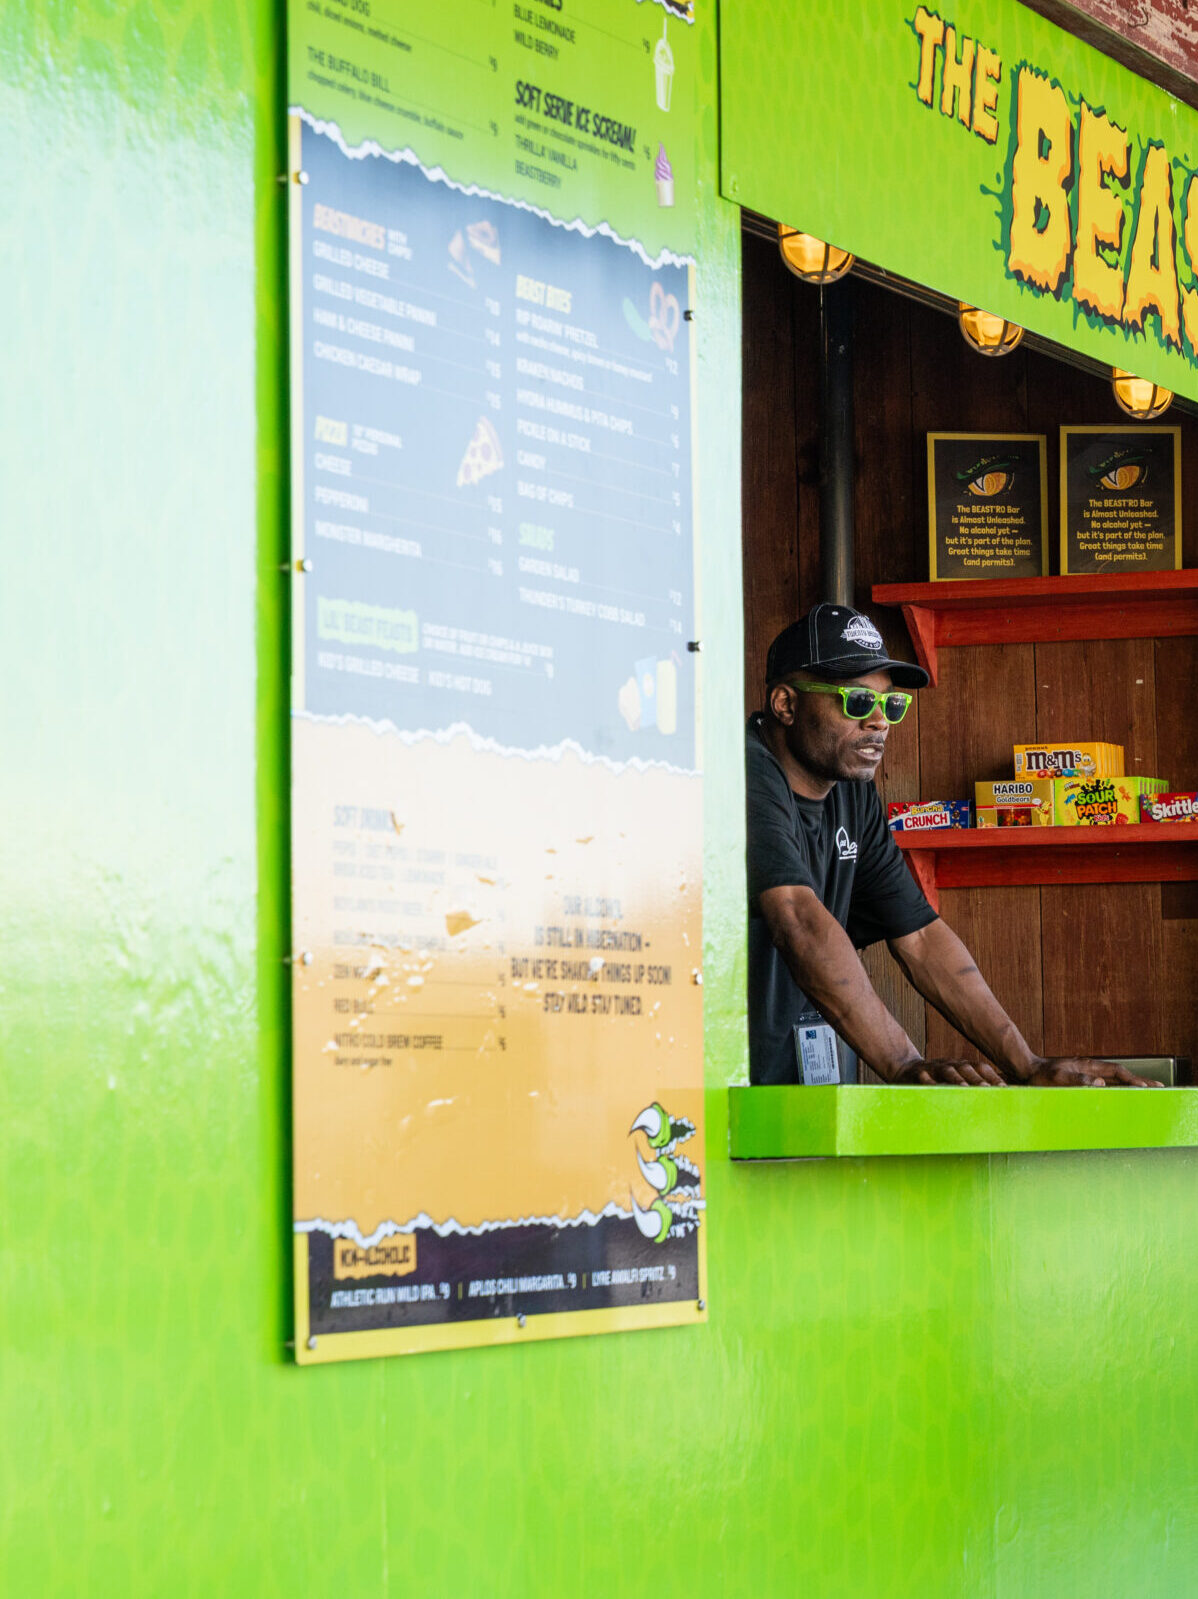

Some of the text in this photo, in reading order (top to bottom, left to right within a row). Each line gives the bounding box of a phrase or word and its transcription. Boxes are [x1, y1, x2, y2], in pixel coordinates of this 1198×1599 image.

[307, 45, 390, 93] THE BUFFALO BILL
[912, 5, 1002, 144] THE
[515, 80, 542, 113] SOFT
[543, 92, 574, 127] SERVE
[575, 105, 591, 134] ICE
[592, 112, 637, 154] SCREAM!
[313, 240, 391, 280] GRILLED CHEESE
[347, 318, 384, 343] CHEESE
[957, 505, 1020, 513] The BEAST'RO Bar
[1089, 499, 1153, 507] The BEAST'RO Bar
[987, 516, 1026, 524] Unleashed.
[1092, 510, 1117, 518] Almost
[1119, 510, 1159, 518] Unleashed.
[960, 526, 1010, 535] No alcohol yet
[1130, 521, 1143, 529] yet
[946, 536, 959, 544] but
[960, 536, 972, 544] it's
[974, 537, 990, 546] part
[1016, 537, 1032, 547] plan.
[1077, 531, 1090, 539] but
[1092, 531, 1104, 539] it's
[1106, 532, 1122, 541] part
[1148, 531, 1165, 541] plan.
[948, 547, 970, 555] Great
[971, 547, 994, 556] things
[1102, 542, 1126, 551] things
[1128, 542, 1144, 550] take
[1146, 542, 1163, 550] time
[1095, 552, 1112, 560] (and
[993, 783, 1033, 794] HARIBO
[1077, 789, 1114, 805] SOUR
[1077, 801, 1117, 818] PATCH
[904, 812, 948, 829] CRUNCH
[547, 926, 572, 948] STILL
[574, 927, 584, 948] IN
[511, 957, 530, 980] BUT
[532, 959, 558, 981] WE'RE
[635, 964, 645, 984] UP
[362, 1033, 384, 1049] COLD
[387, 1034, 410, 1049] BREW
[412, 1035, 443, 1050] COFFEE
[398, 1285, 419, 1304] WILD
